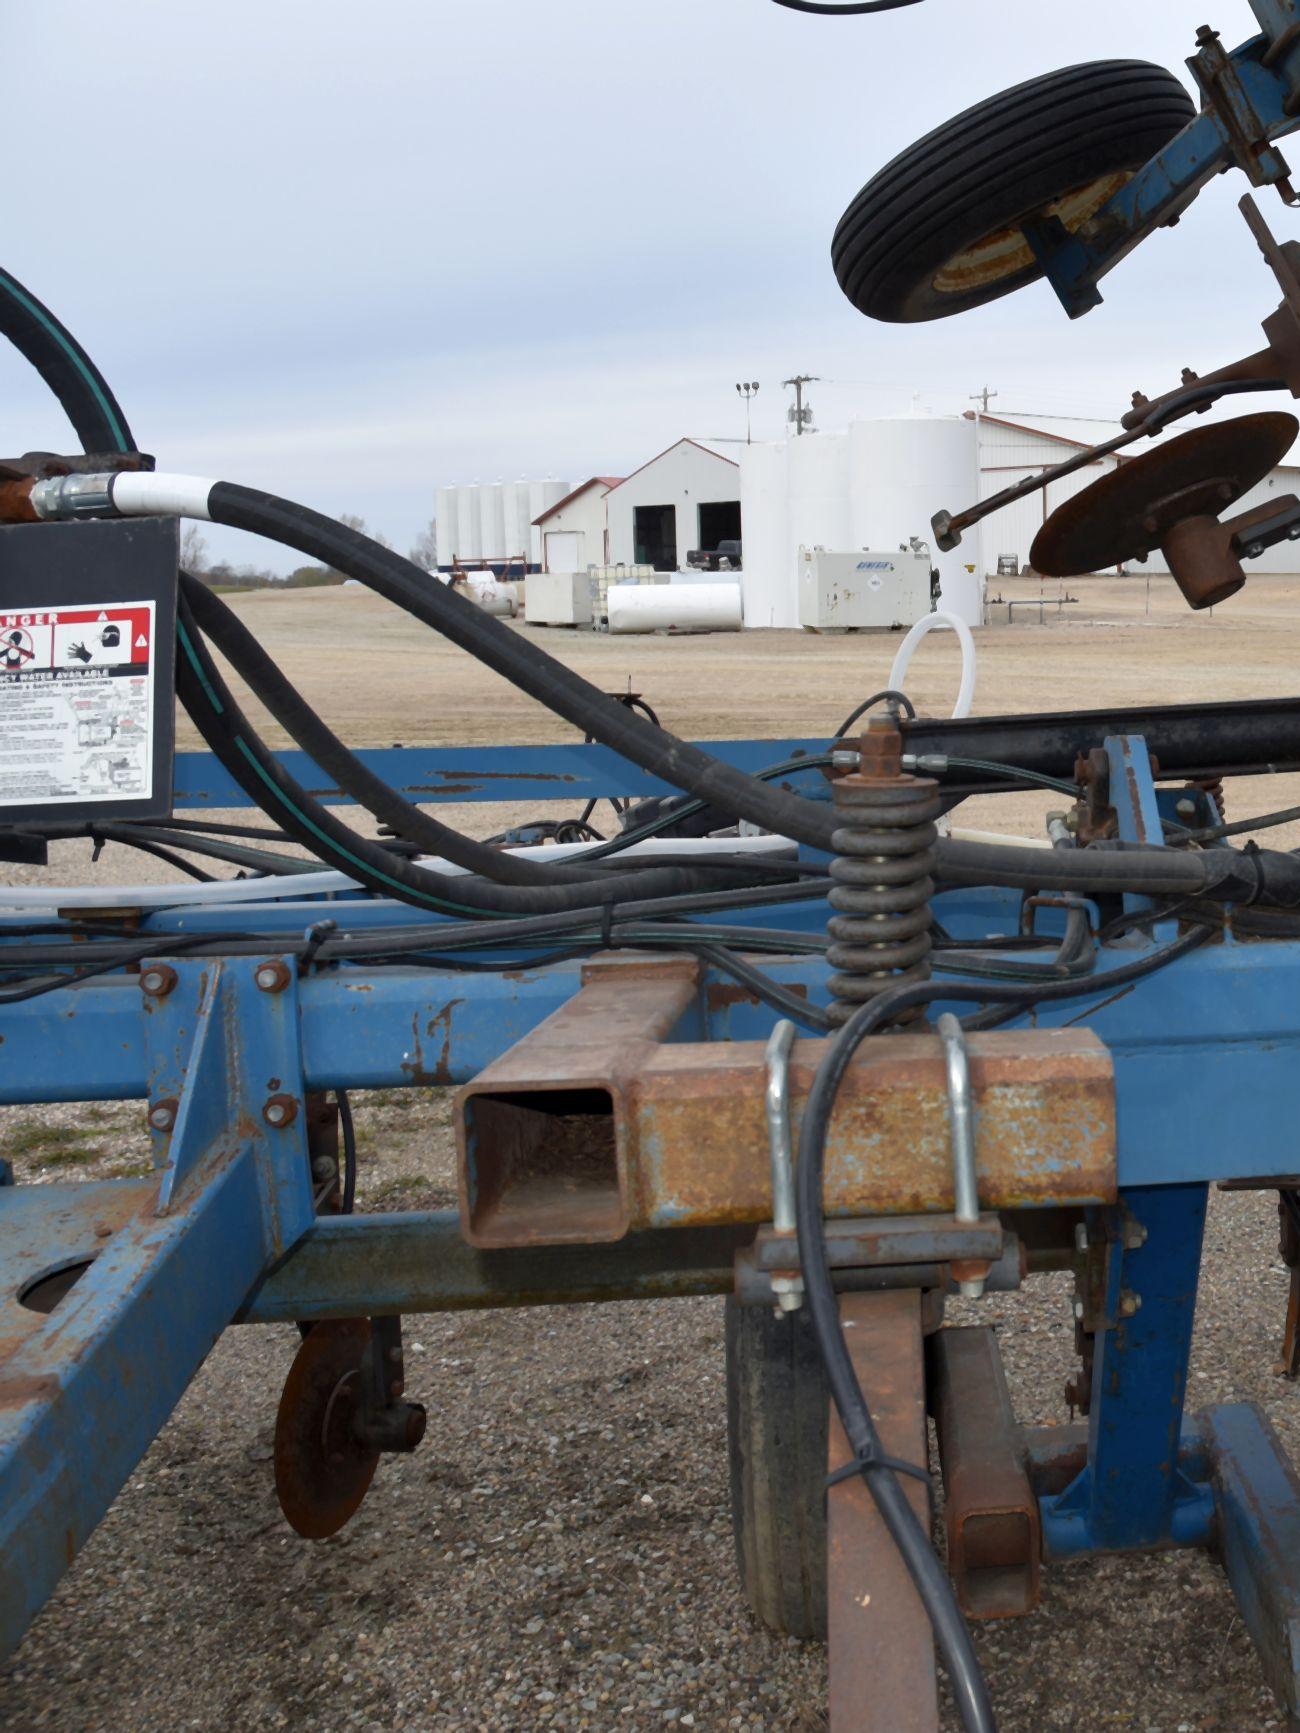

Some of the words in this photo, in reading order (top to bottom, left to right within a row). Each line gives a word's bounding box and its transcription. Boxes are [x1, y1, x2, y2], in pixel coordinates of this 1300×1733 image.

[0, 613, 58, 627] NGER
[19, 672, 54, 683] WATER
[55, 669, 109, 681] AVAILABLE
[62, 680, 113, 688] INSTRUCTIONS
